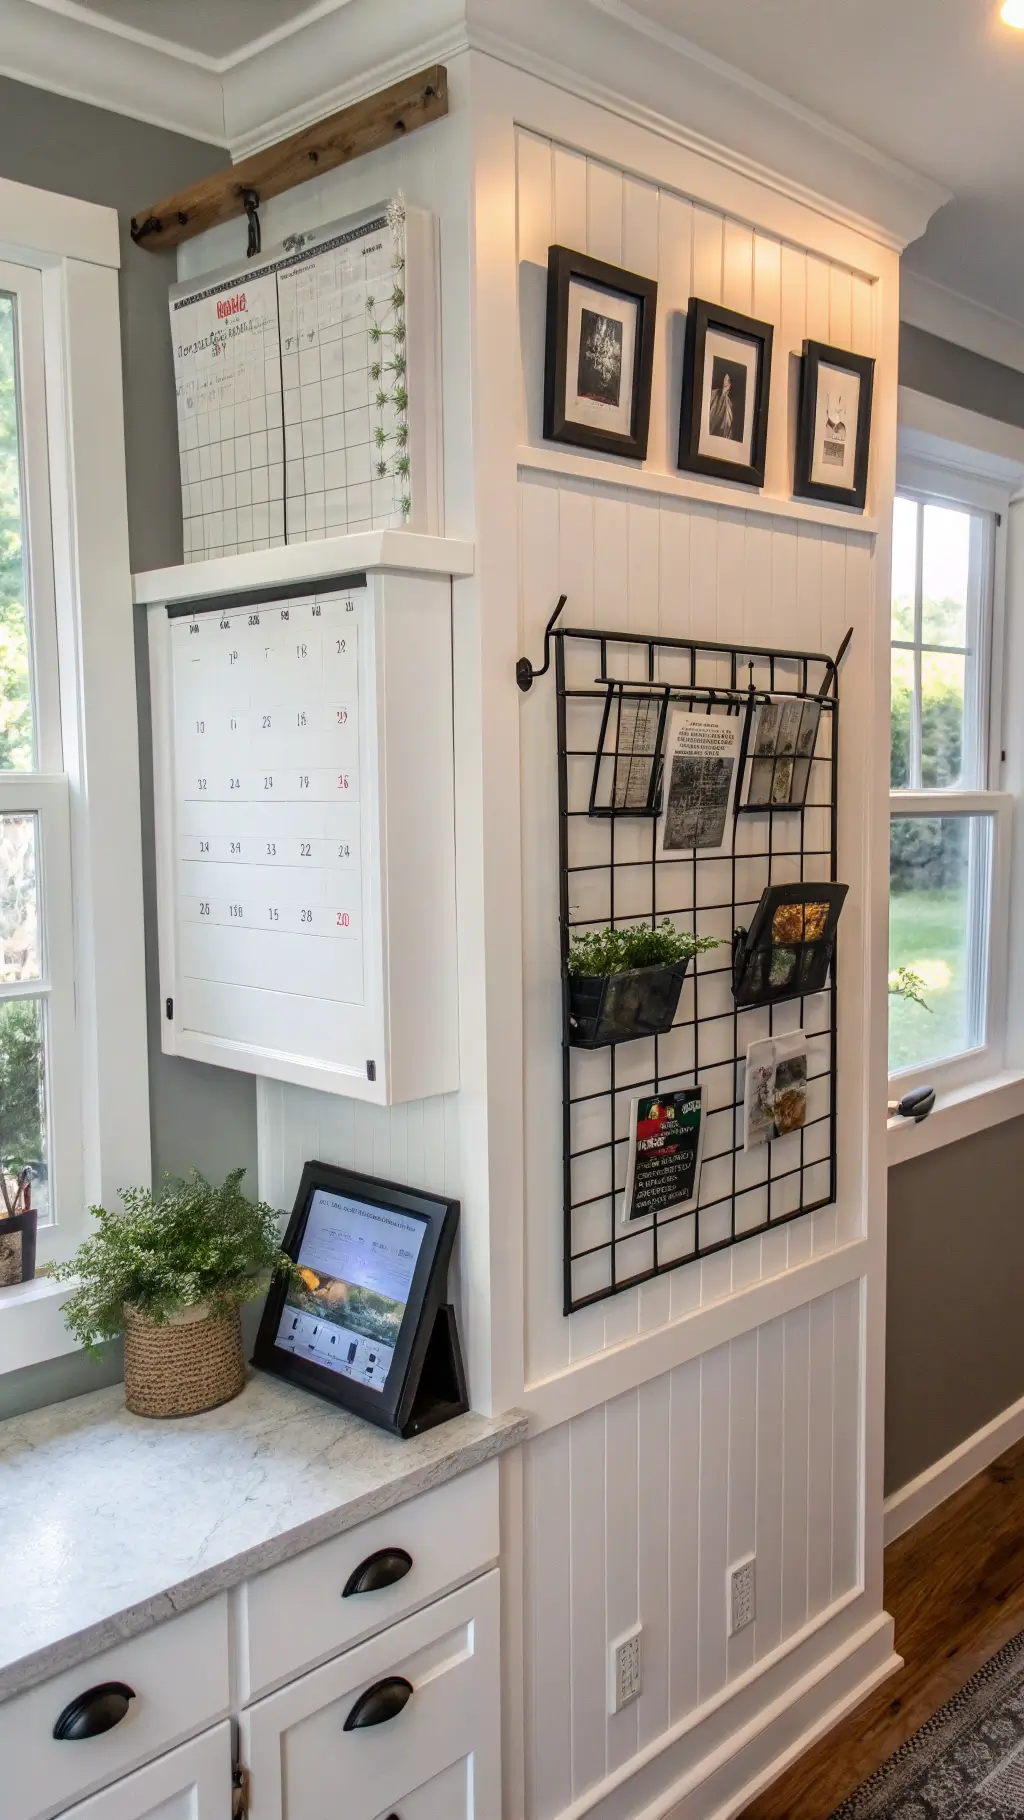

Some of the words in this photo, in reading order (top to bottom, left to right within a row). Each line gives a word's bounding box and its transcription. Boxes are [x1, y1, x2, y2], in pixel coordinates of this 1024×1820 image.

[230, 779, 240, 788] 24
[266, 844, 276, 855] 33
[300, 844, 312, 856] 22
